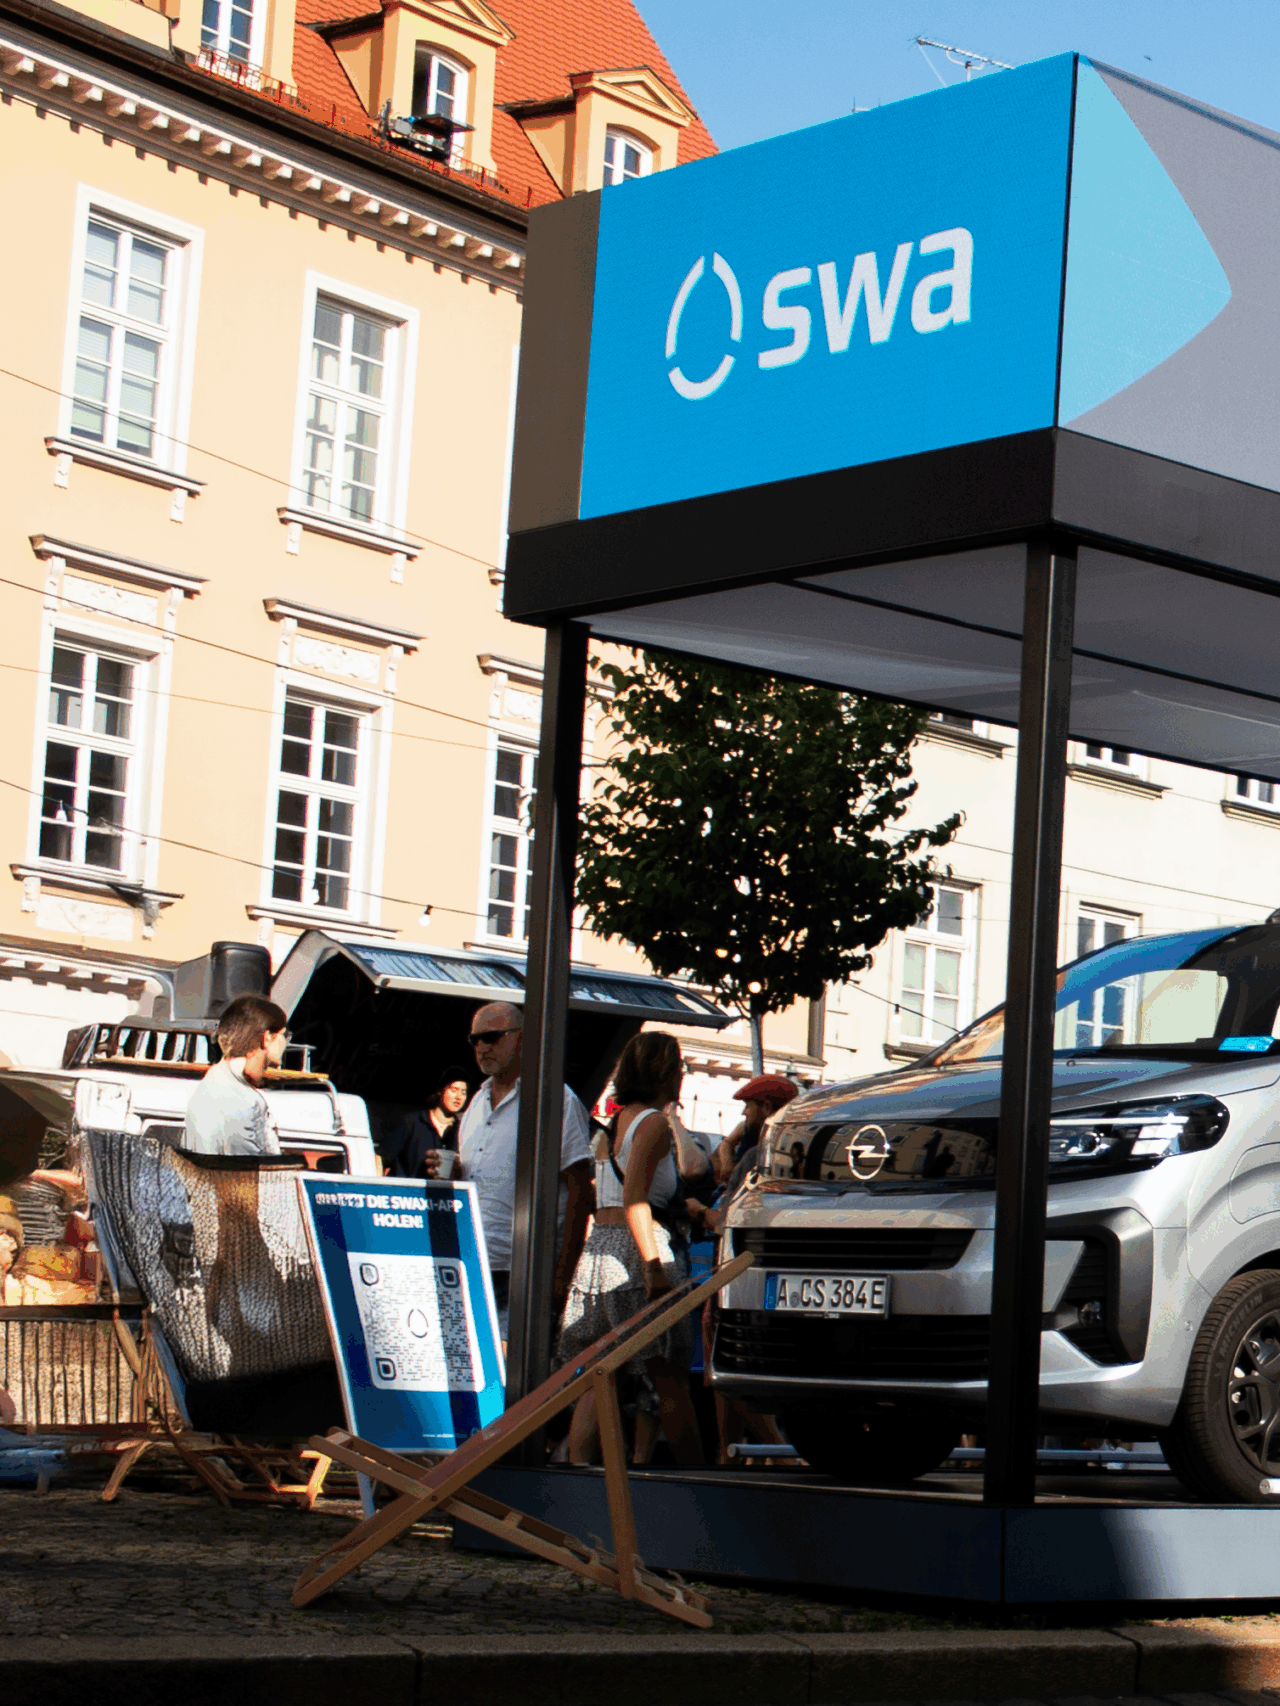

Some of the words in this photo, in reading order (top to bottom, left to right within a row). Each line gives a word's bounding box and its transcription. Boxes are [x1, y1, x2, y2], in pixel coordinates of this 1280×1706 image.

[757, 226, 975, 370] swa
[366, 1193, 390, 1209] DIE
[390, 1195, 464, 1214] SWAXI-APP
[371, 1212, 425, 1229] HOLEN!
[777, 1278, 788, 1308] A
[801, 1278, 826, 1308] CS
